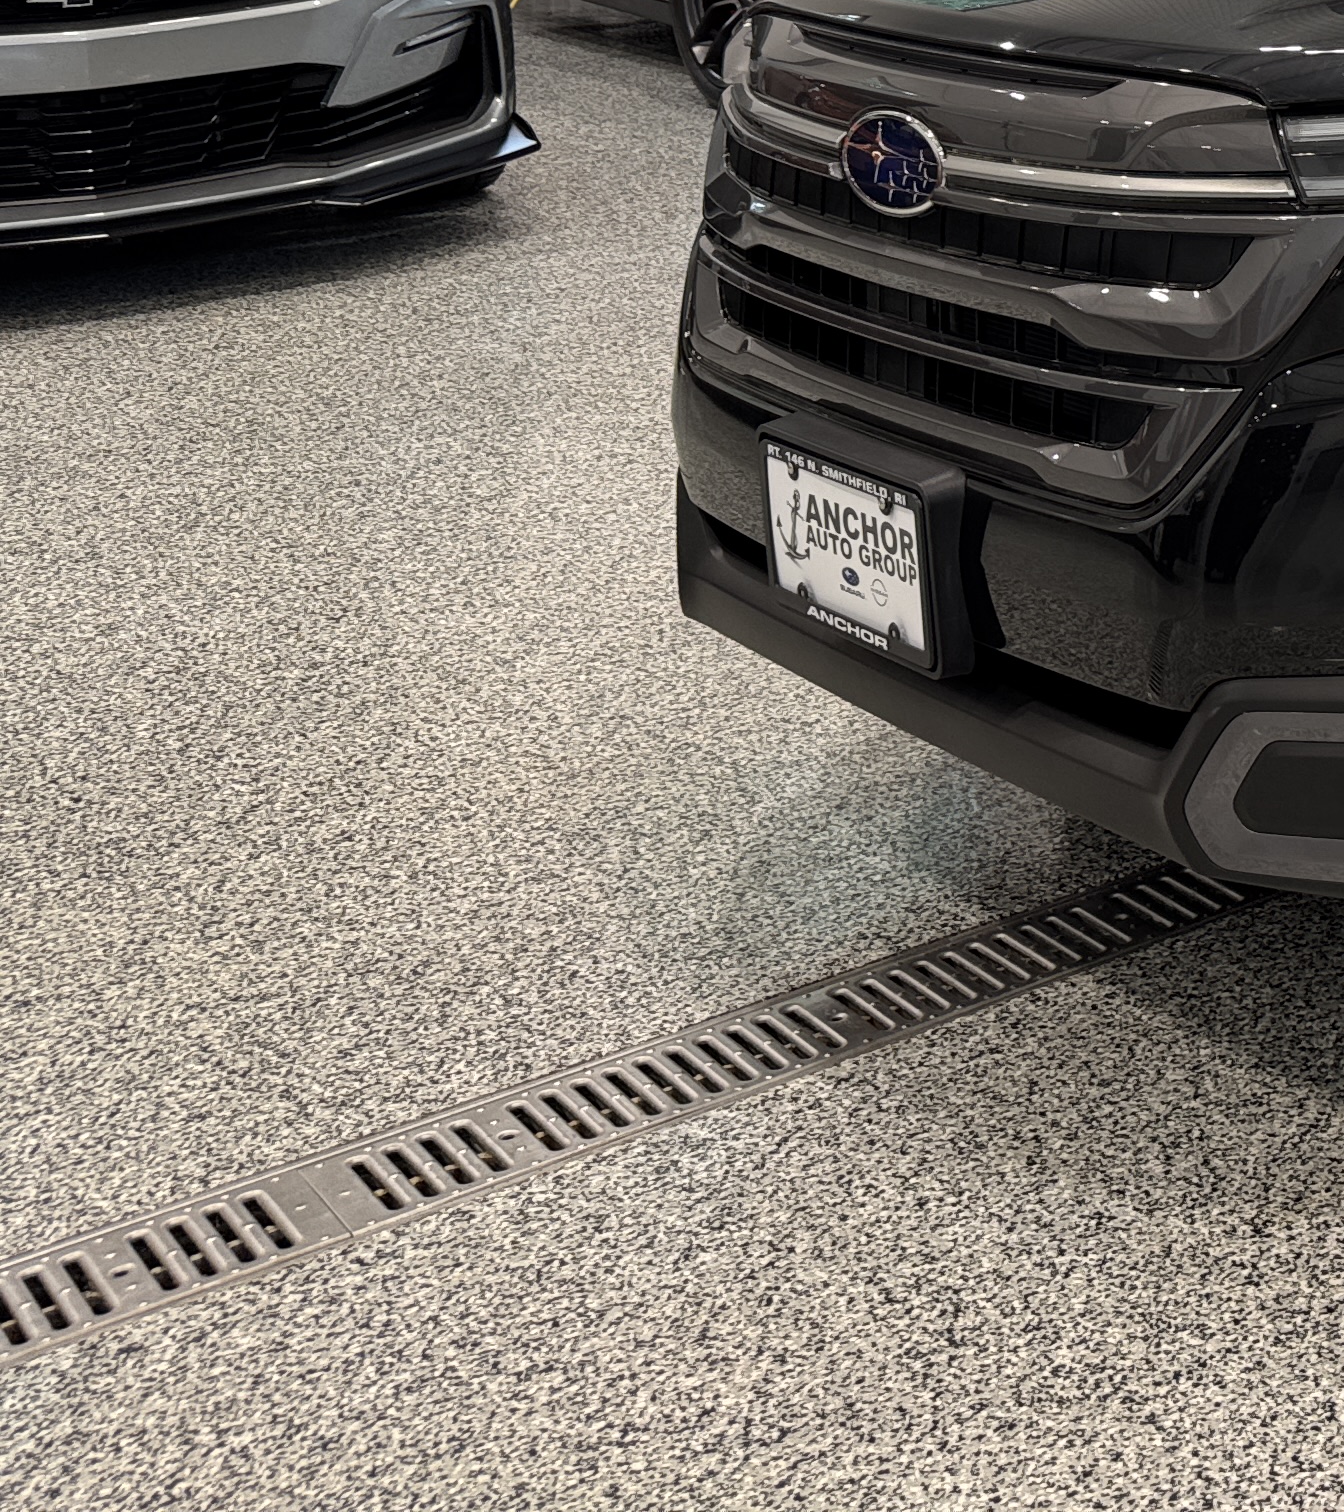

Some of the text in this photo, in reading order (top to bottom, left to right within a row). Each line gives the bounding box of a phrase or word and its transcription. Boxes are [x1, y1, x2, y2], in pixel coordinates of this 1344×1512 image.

[767, 443, 782, 459] RT.
[784, 451, 805, 468] 146
[806, 459, 820, 474] N.
[893, 491, 907, 506] RI
[806, 493, 916, 566] ANCHOR
[806, 524, 917, 587] AUTO GROUP
[807, 605, 889, 651] ANCHOR
